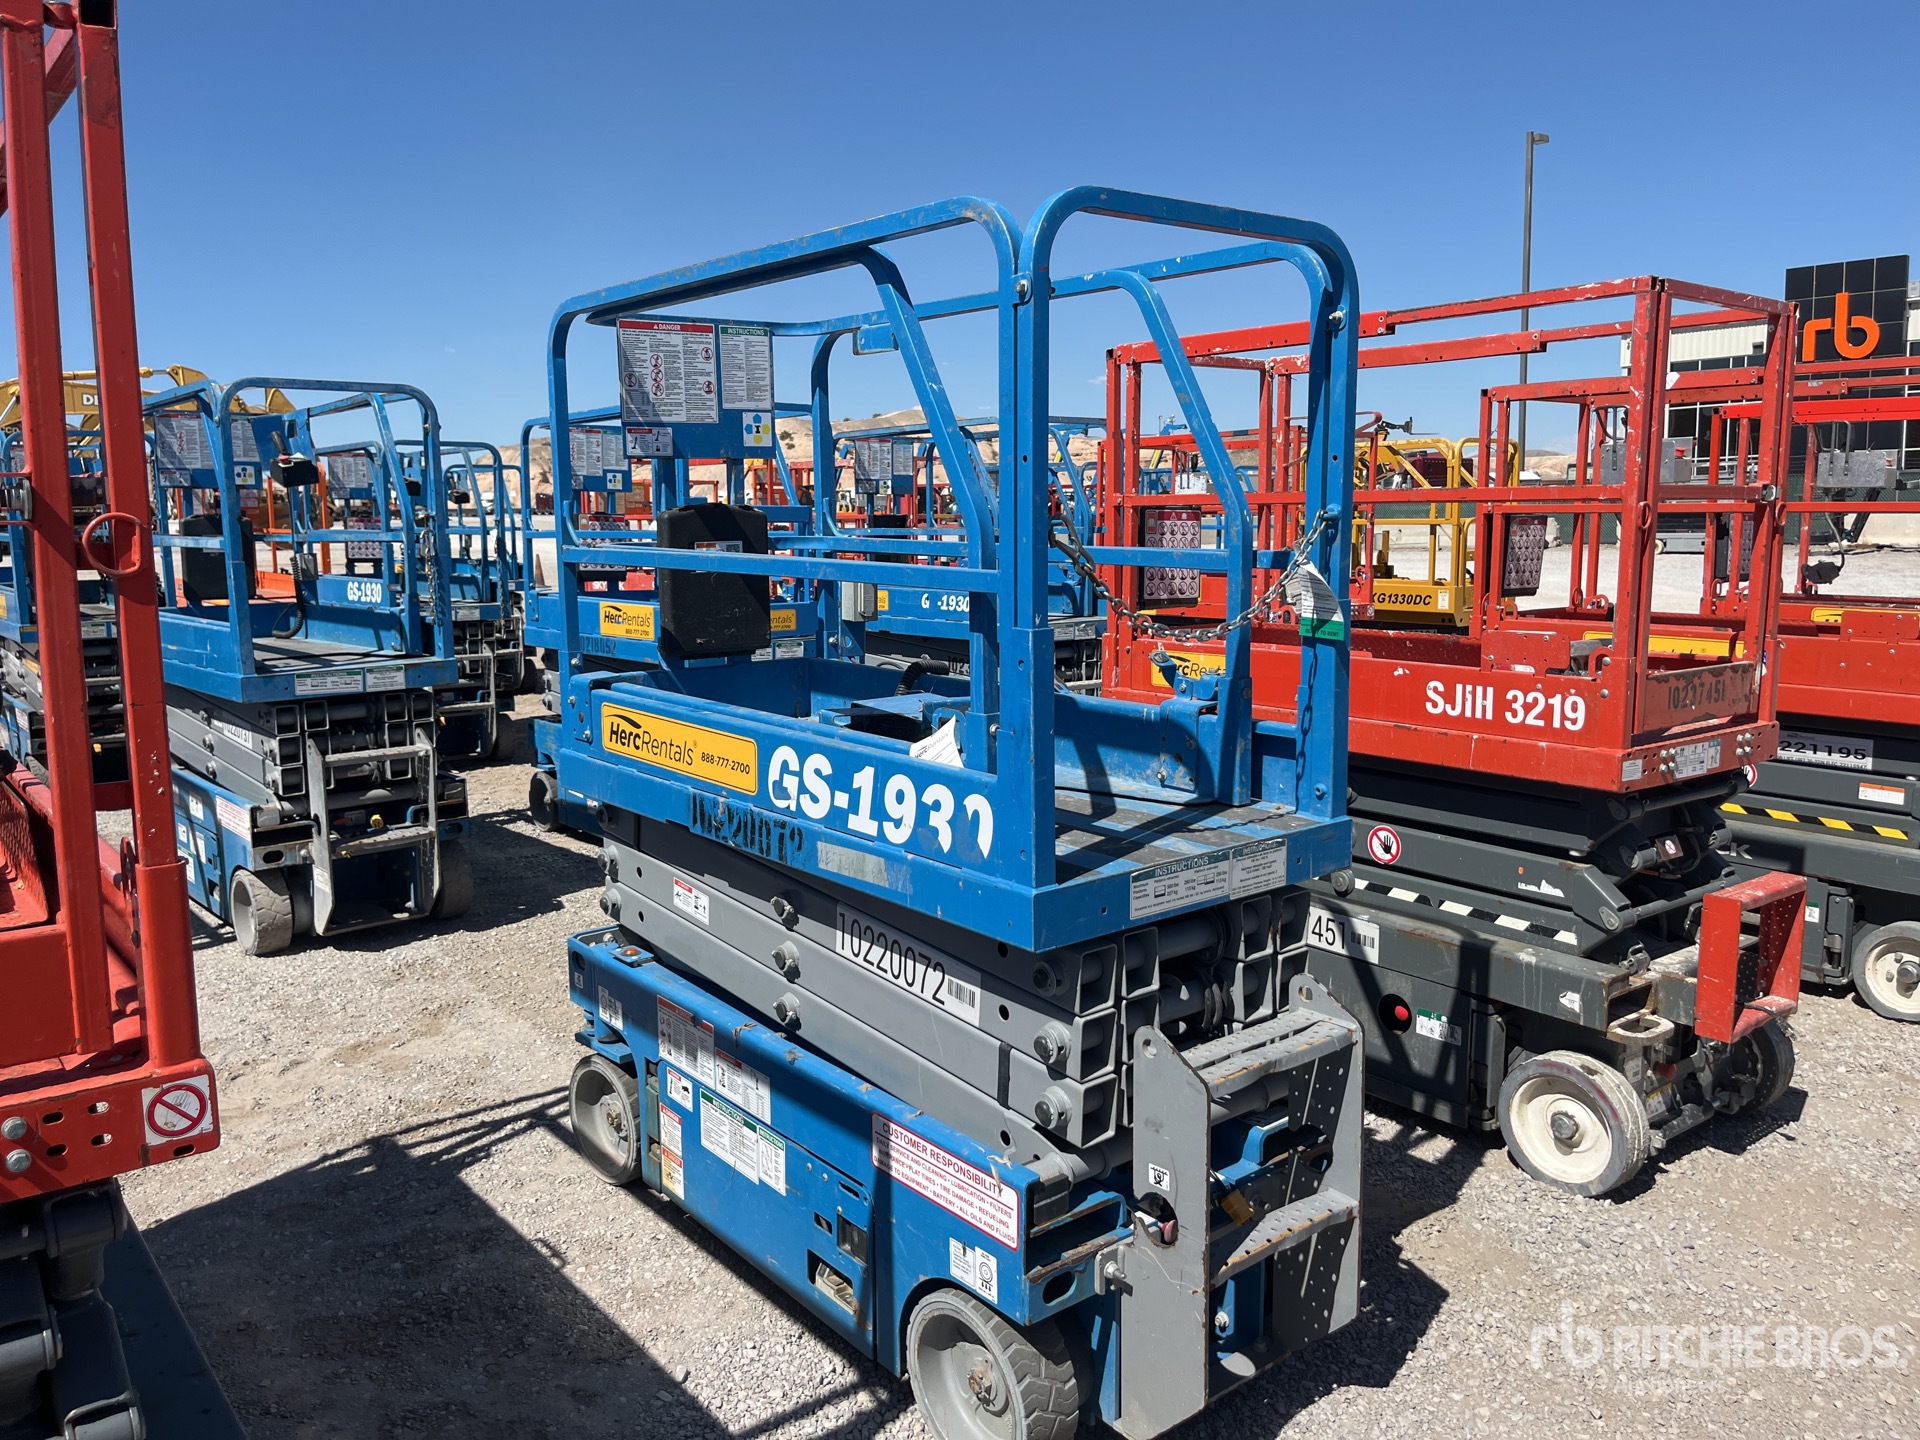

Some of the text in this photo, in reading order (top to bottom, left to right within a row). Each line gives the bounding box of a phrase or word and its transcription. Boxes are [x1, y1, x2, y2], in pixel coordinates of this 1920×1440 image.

[727, 328, 765, 336] INSTRUCTIONS
[347, 581, 382, 604] GS-1930
[1505, 689, 1586, 731] 3219
[701, 752, 751, 775] 888-777-2700
[1155, 857, 1209, 877] INSTRUCTIONS
[839, 912, 945, 1006] 10220072
[876, 1137, 1012, 1219] DAILY SERVICE AND CLEANING LUBRICATION FILTERS
[882, 1122, 1003, 1197] CUSTOMER RESPONSIBILITY
[873, 1155, 1016, 1244] DAMAGE TO EQUIPMENT BATTERY ALL OILS AND FLUIDS
[921, 1173, 936, 1186] TIRES
[940, 1183, 951, 1195] TIRE
[951, 1190, 975, 1209] DAMAGE
[978, 1205, 1010, 1229] REFUELING
